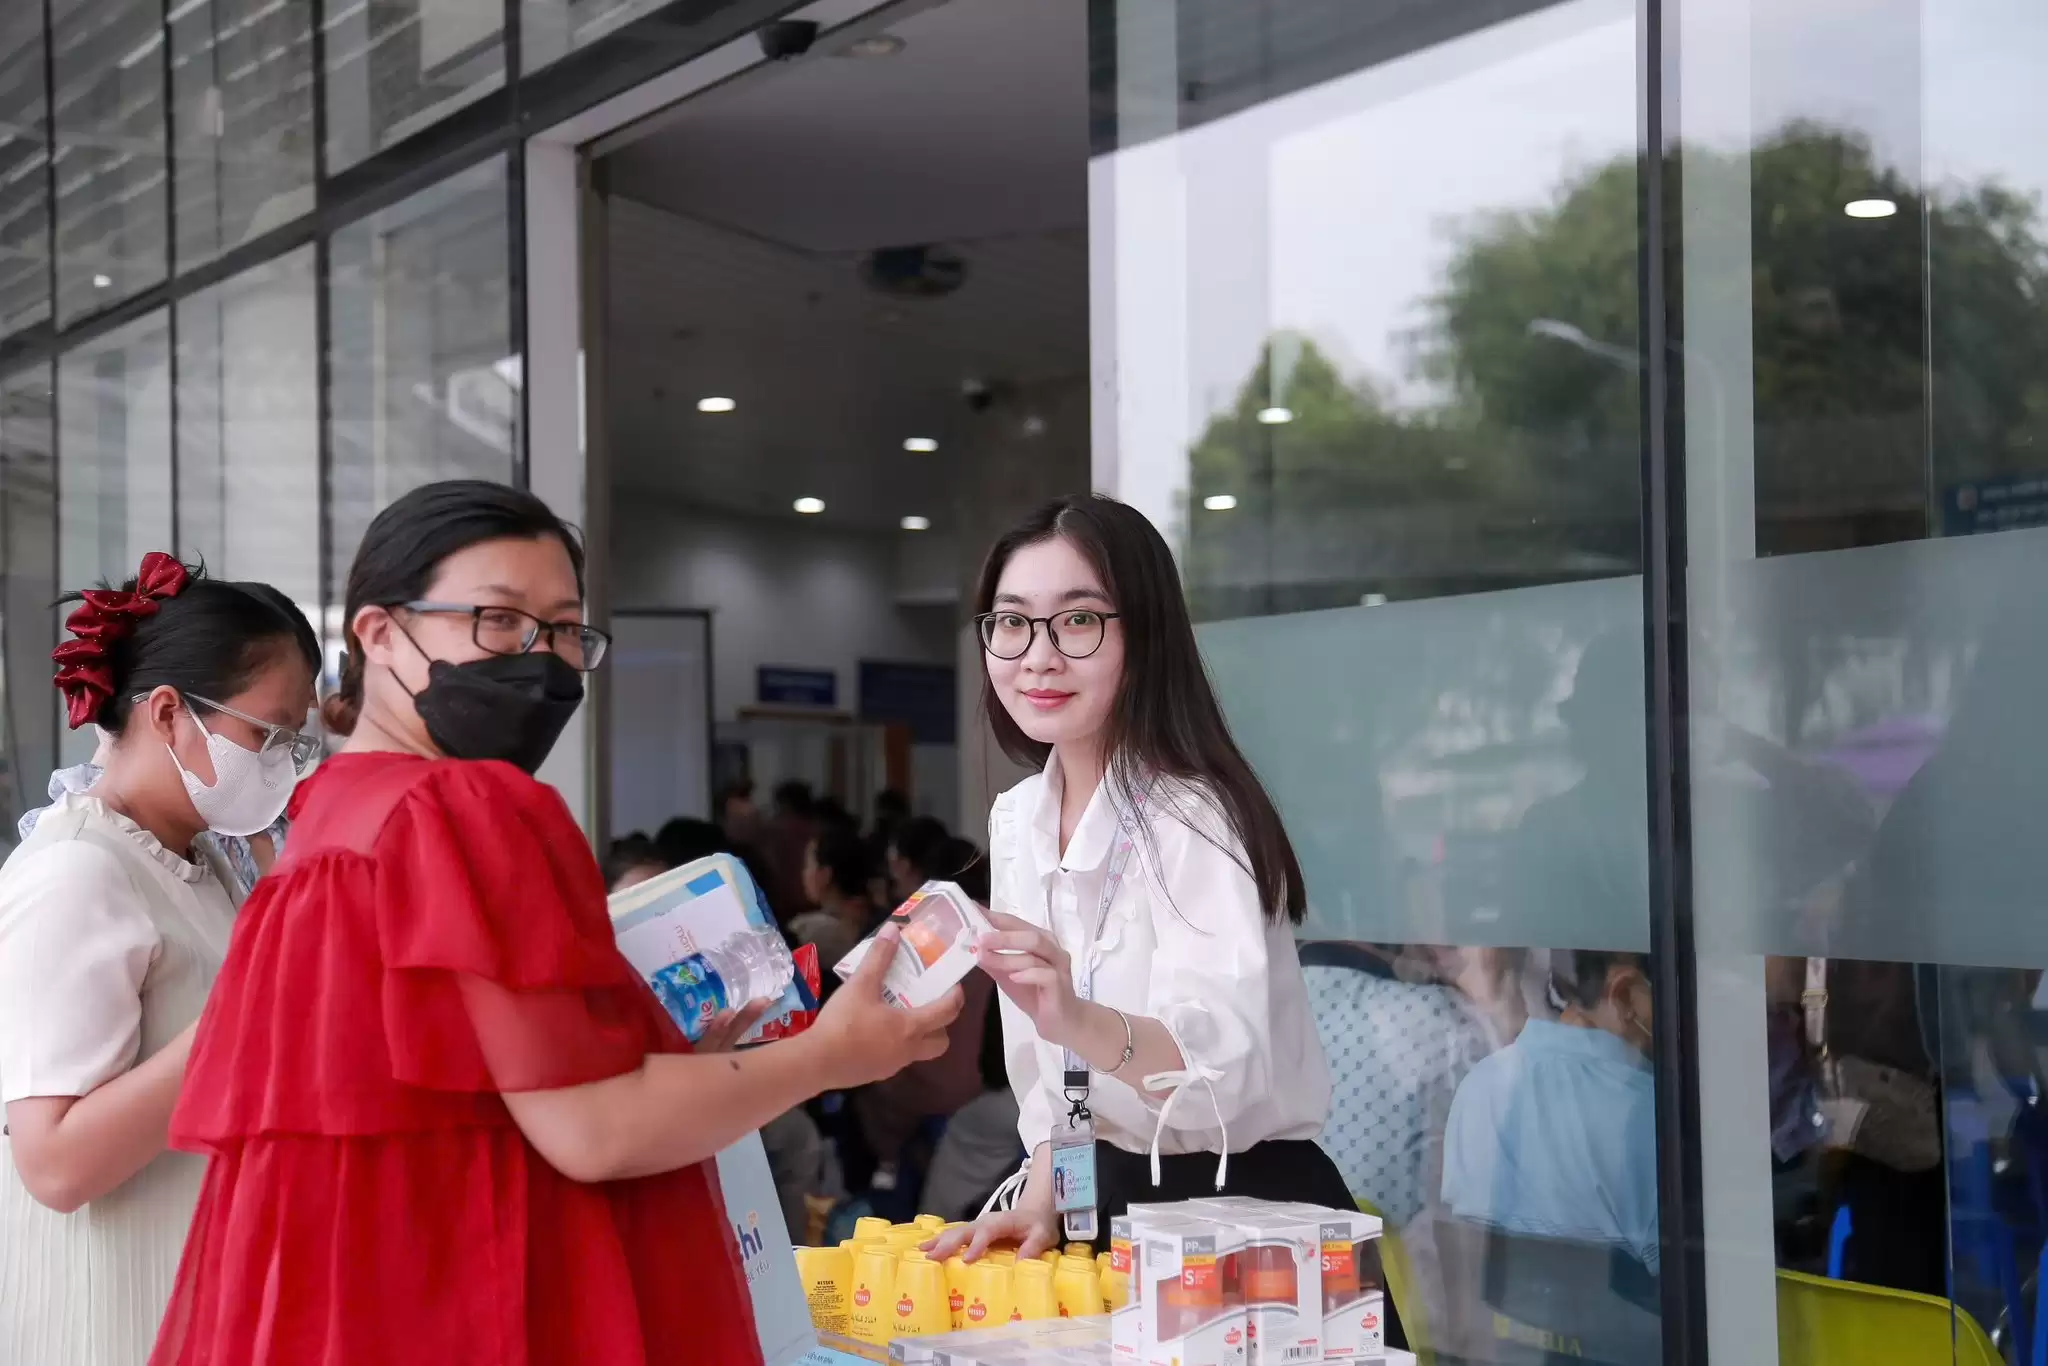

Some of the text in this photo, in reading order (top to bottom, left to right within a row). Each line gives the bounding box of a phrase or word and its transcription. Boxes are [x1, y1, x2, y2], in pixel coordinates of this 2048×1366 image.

[1321, 1228, 1335, 1241] PP
[1184, 1240, 1200, 1253] PP
[1111, 1250, 1120, 1267] S
[1321, 1255, 1332, 1272] S
[1183, 1269, 1195, 1286] S
